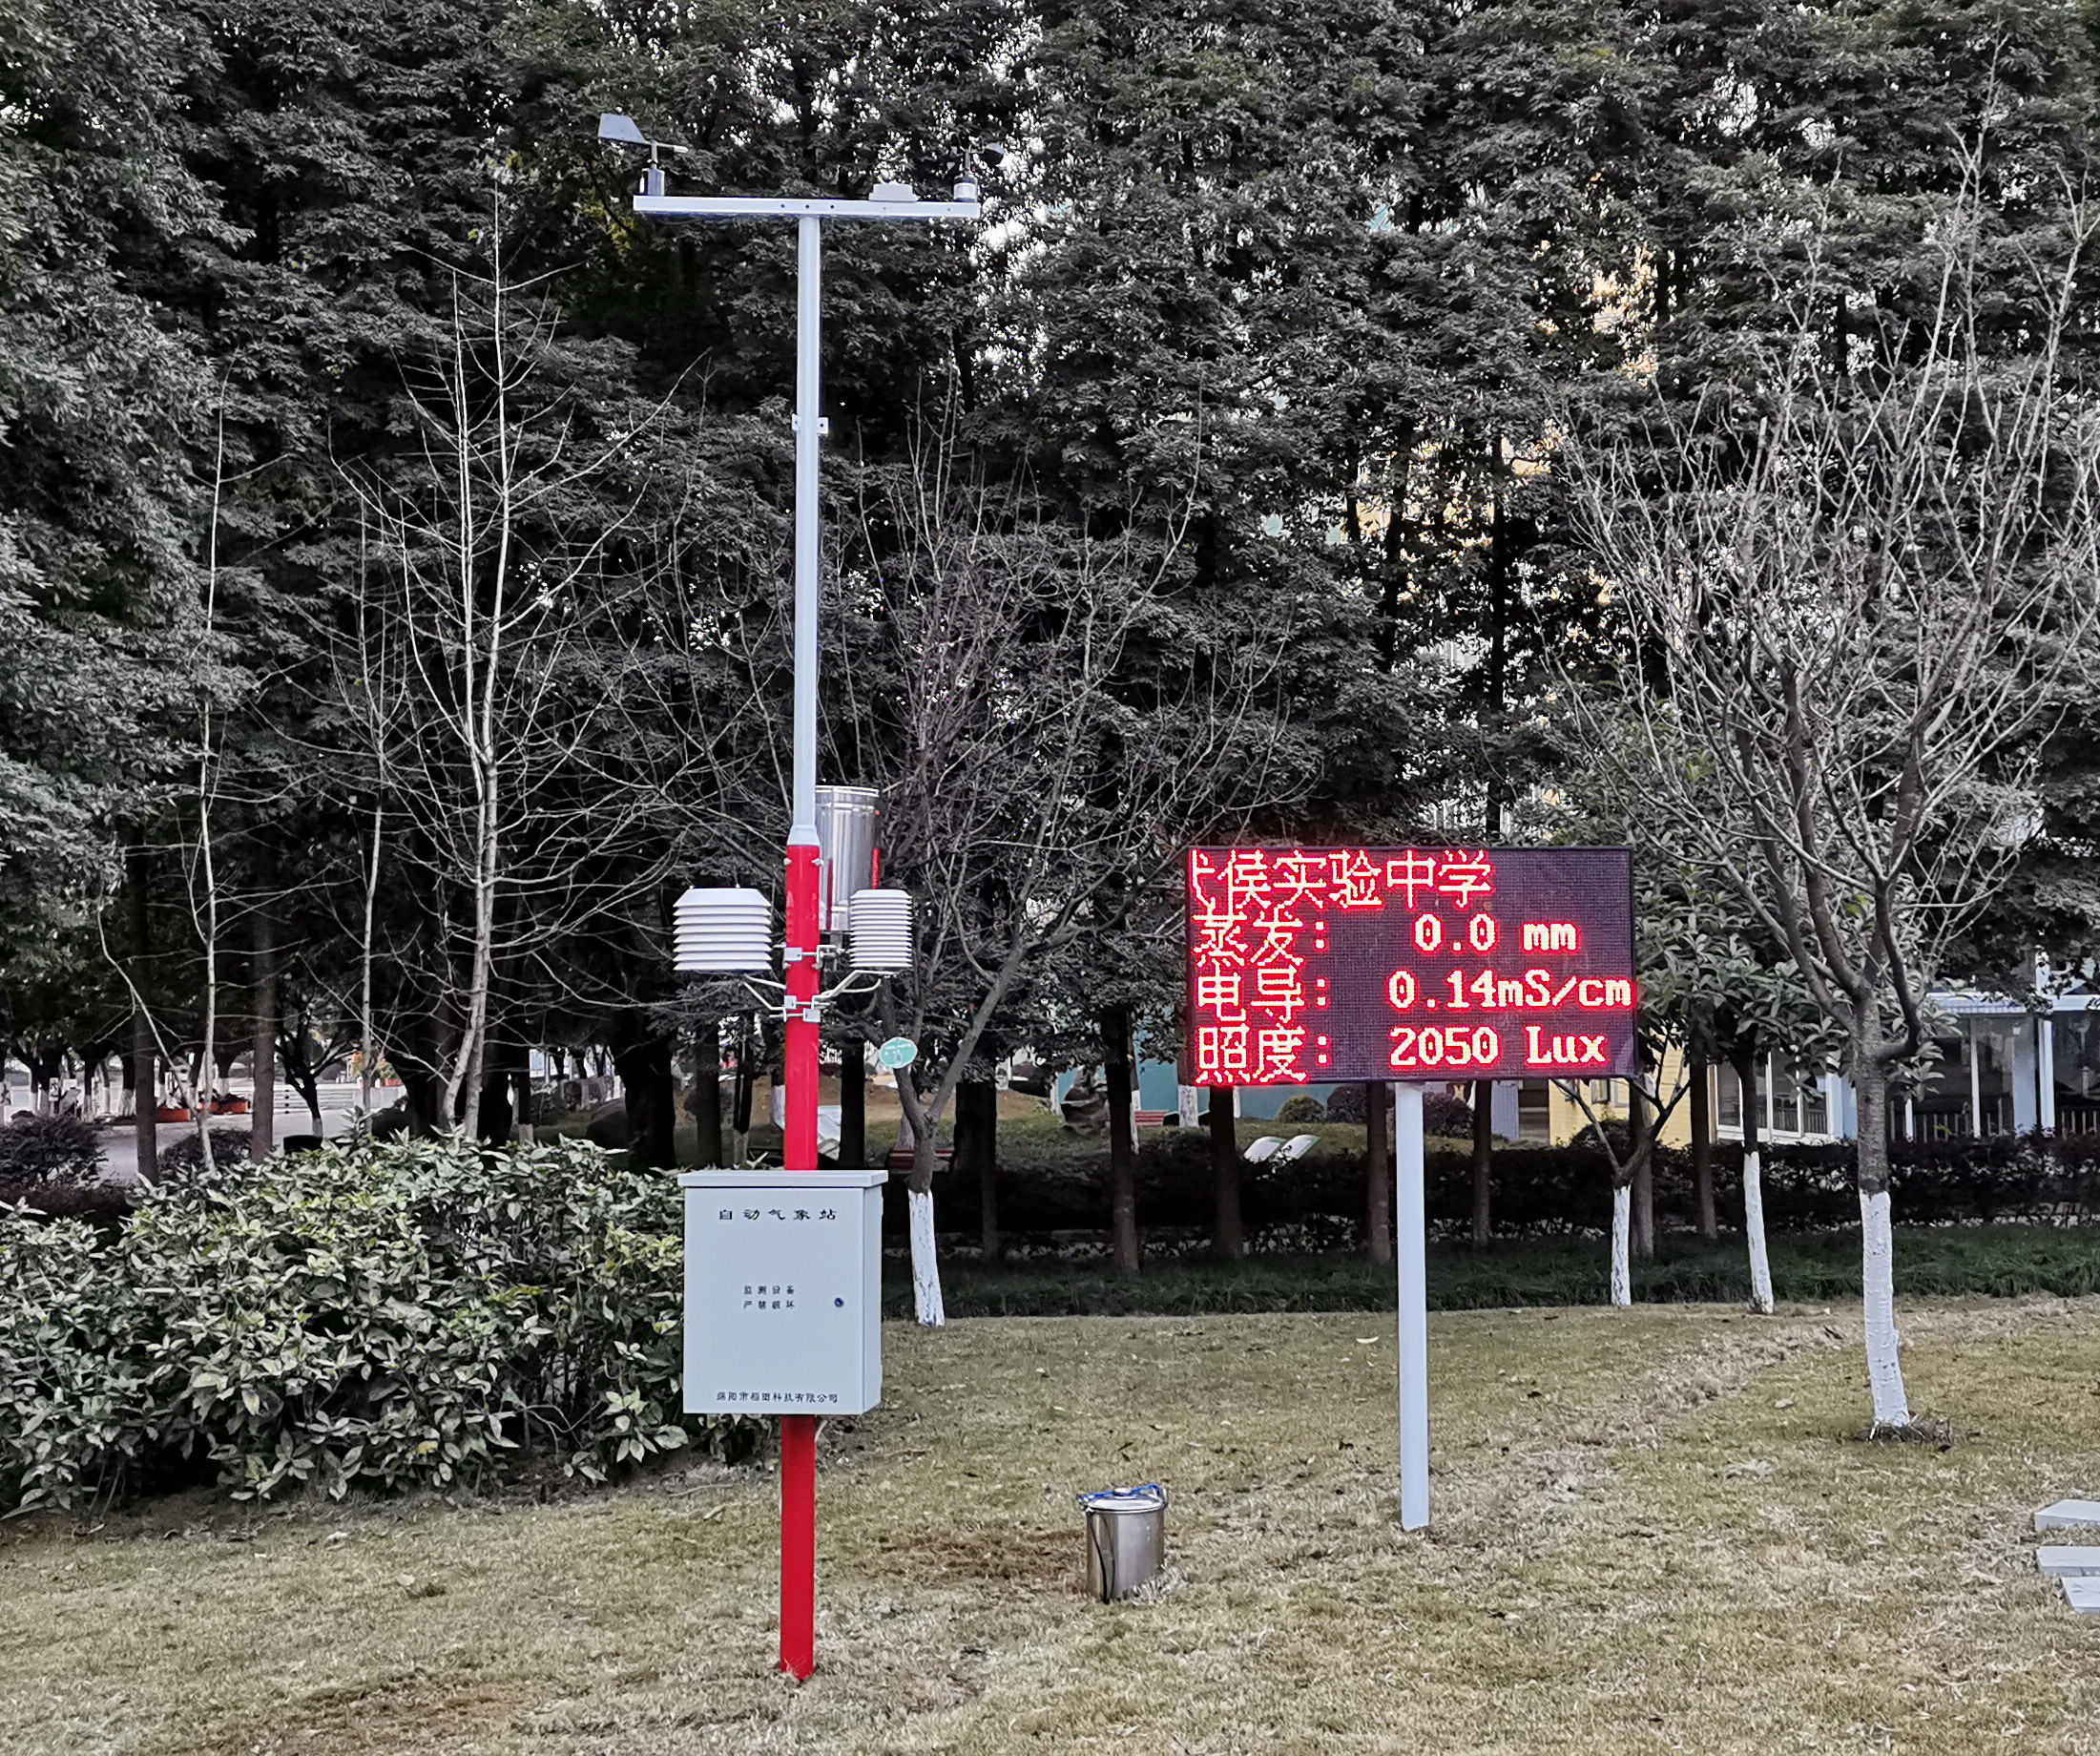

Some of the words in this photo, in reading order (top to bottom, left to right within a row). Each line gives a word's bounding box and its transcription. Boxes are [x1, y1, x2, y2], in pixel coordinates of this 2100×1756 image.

[1414, 913, 1495, 951] 0.0
[1523, 923, 1577, 951] mm
[1197, 958, 1326, 1023] 电导：
[1388, 969, 1632, 1008] 0.14mS/cm
[1195, 1023, 1327, 1082] 照度：
[1389, 1027, 1499, 1066] 2050
[1525, 1026, 1607, 1064] Lux
[718, 1208, 838, 1222] 自动气象站
[743, 1285, 795, 1295] 监测设备
[743, 1300, 795, 1310] 严禁破坏
